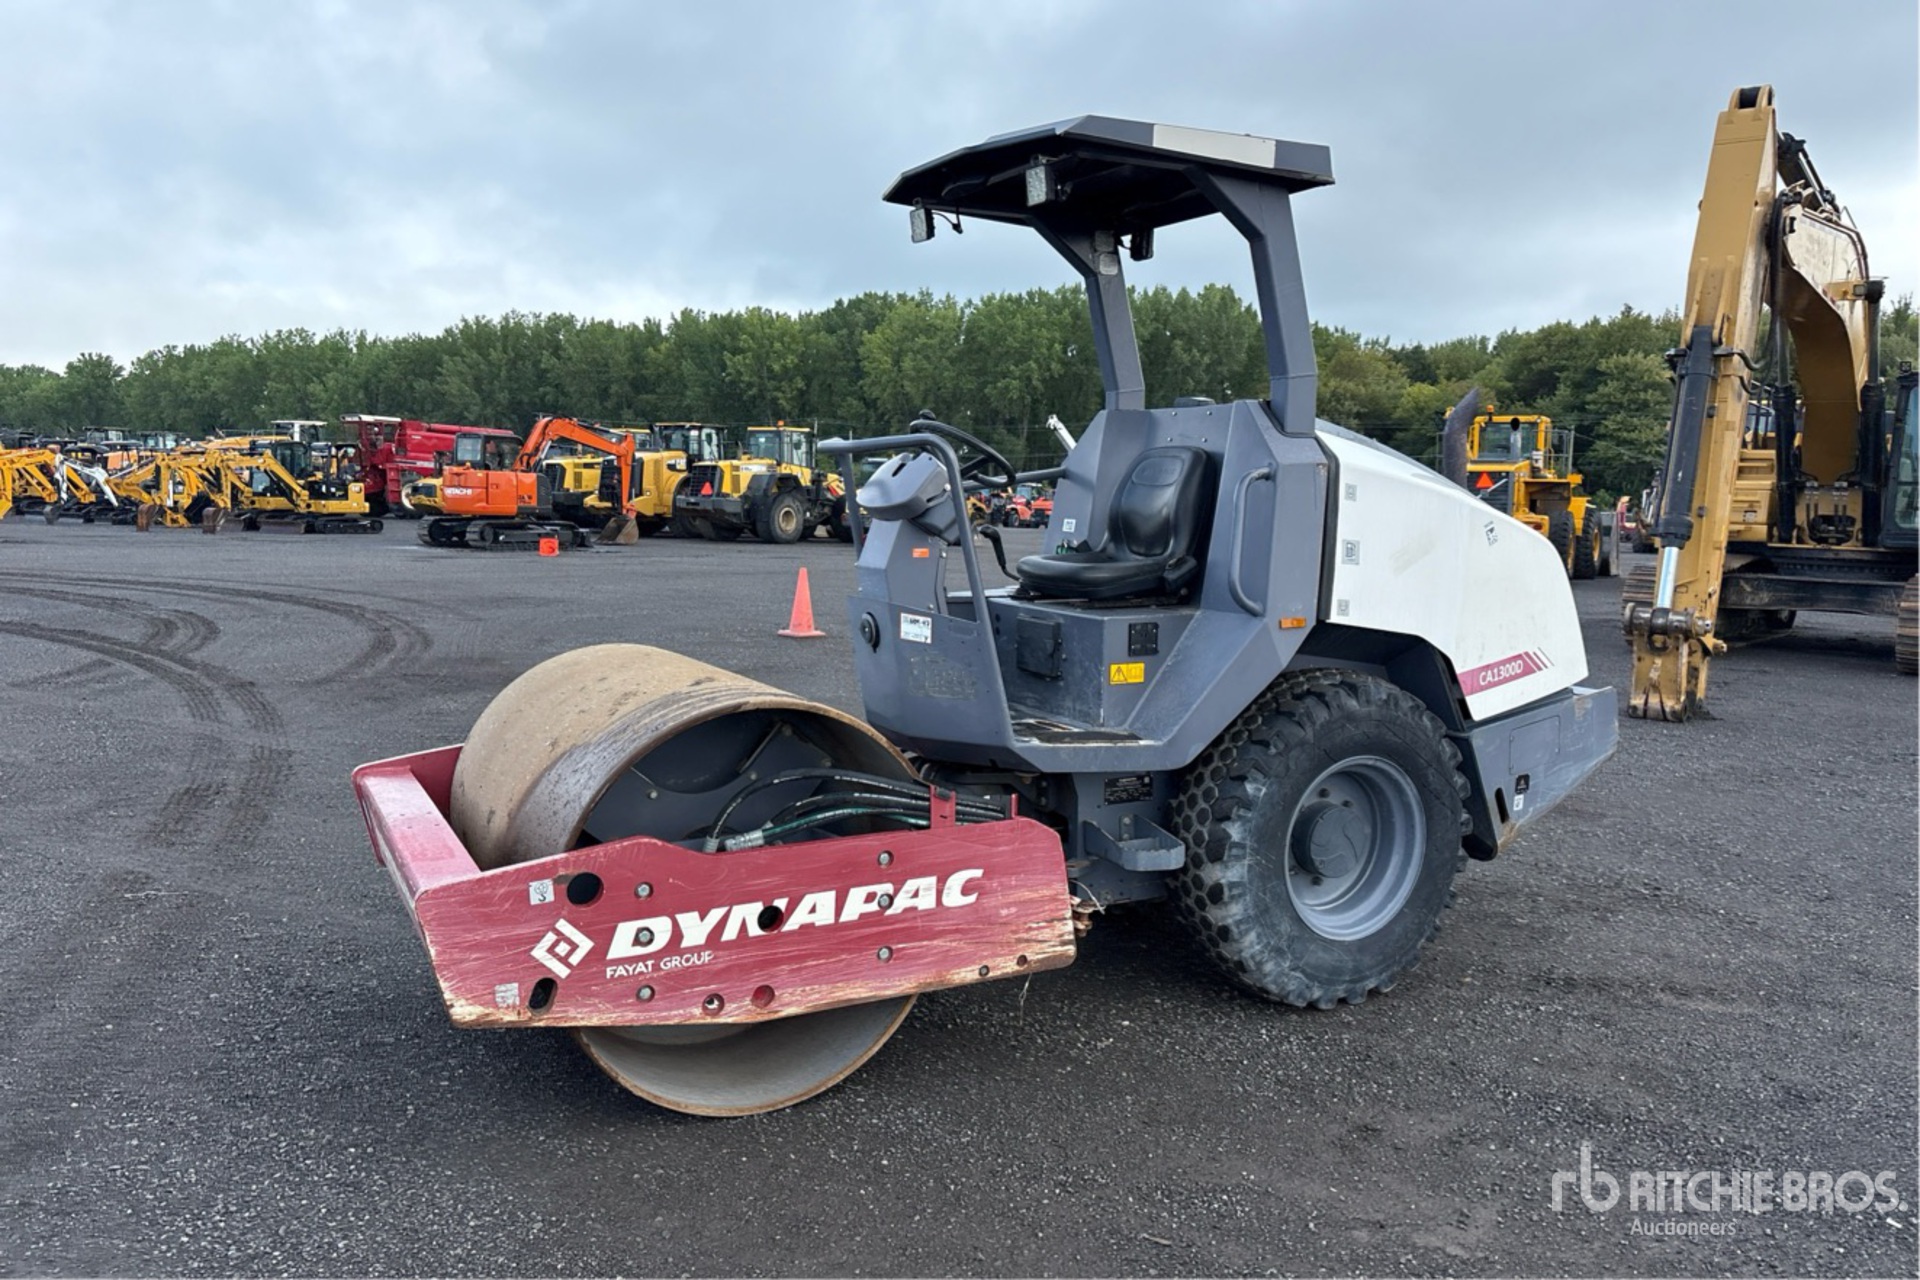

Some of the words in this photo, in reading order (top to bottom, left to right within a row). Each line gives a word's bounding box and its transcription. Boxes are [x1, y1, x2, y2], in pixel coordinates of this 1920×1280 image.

[1480, 660, 1524, 685] CA1300D
[606, 868, 984, 960] DYNAPAC
[606, 960, 655, 979] FAYAT
[660, 950, 715, 970] GROUP
